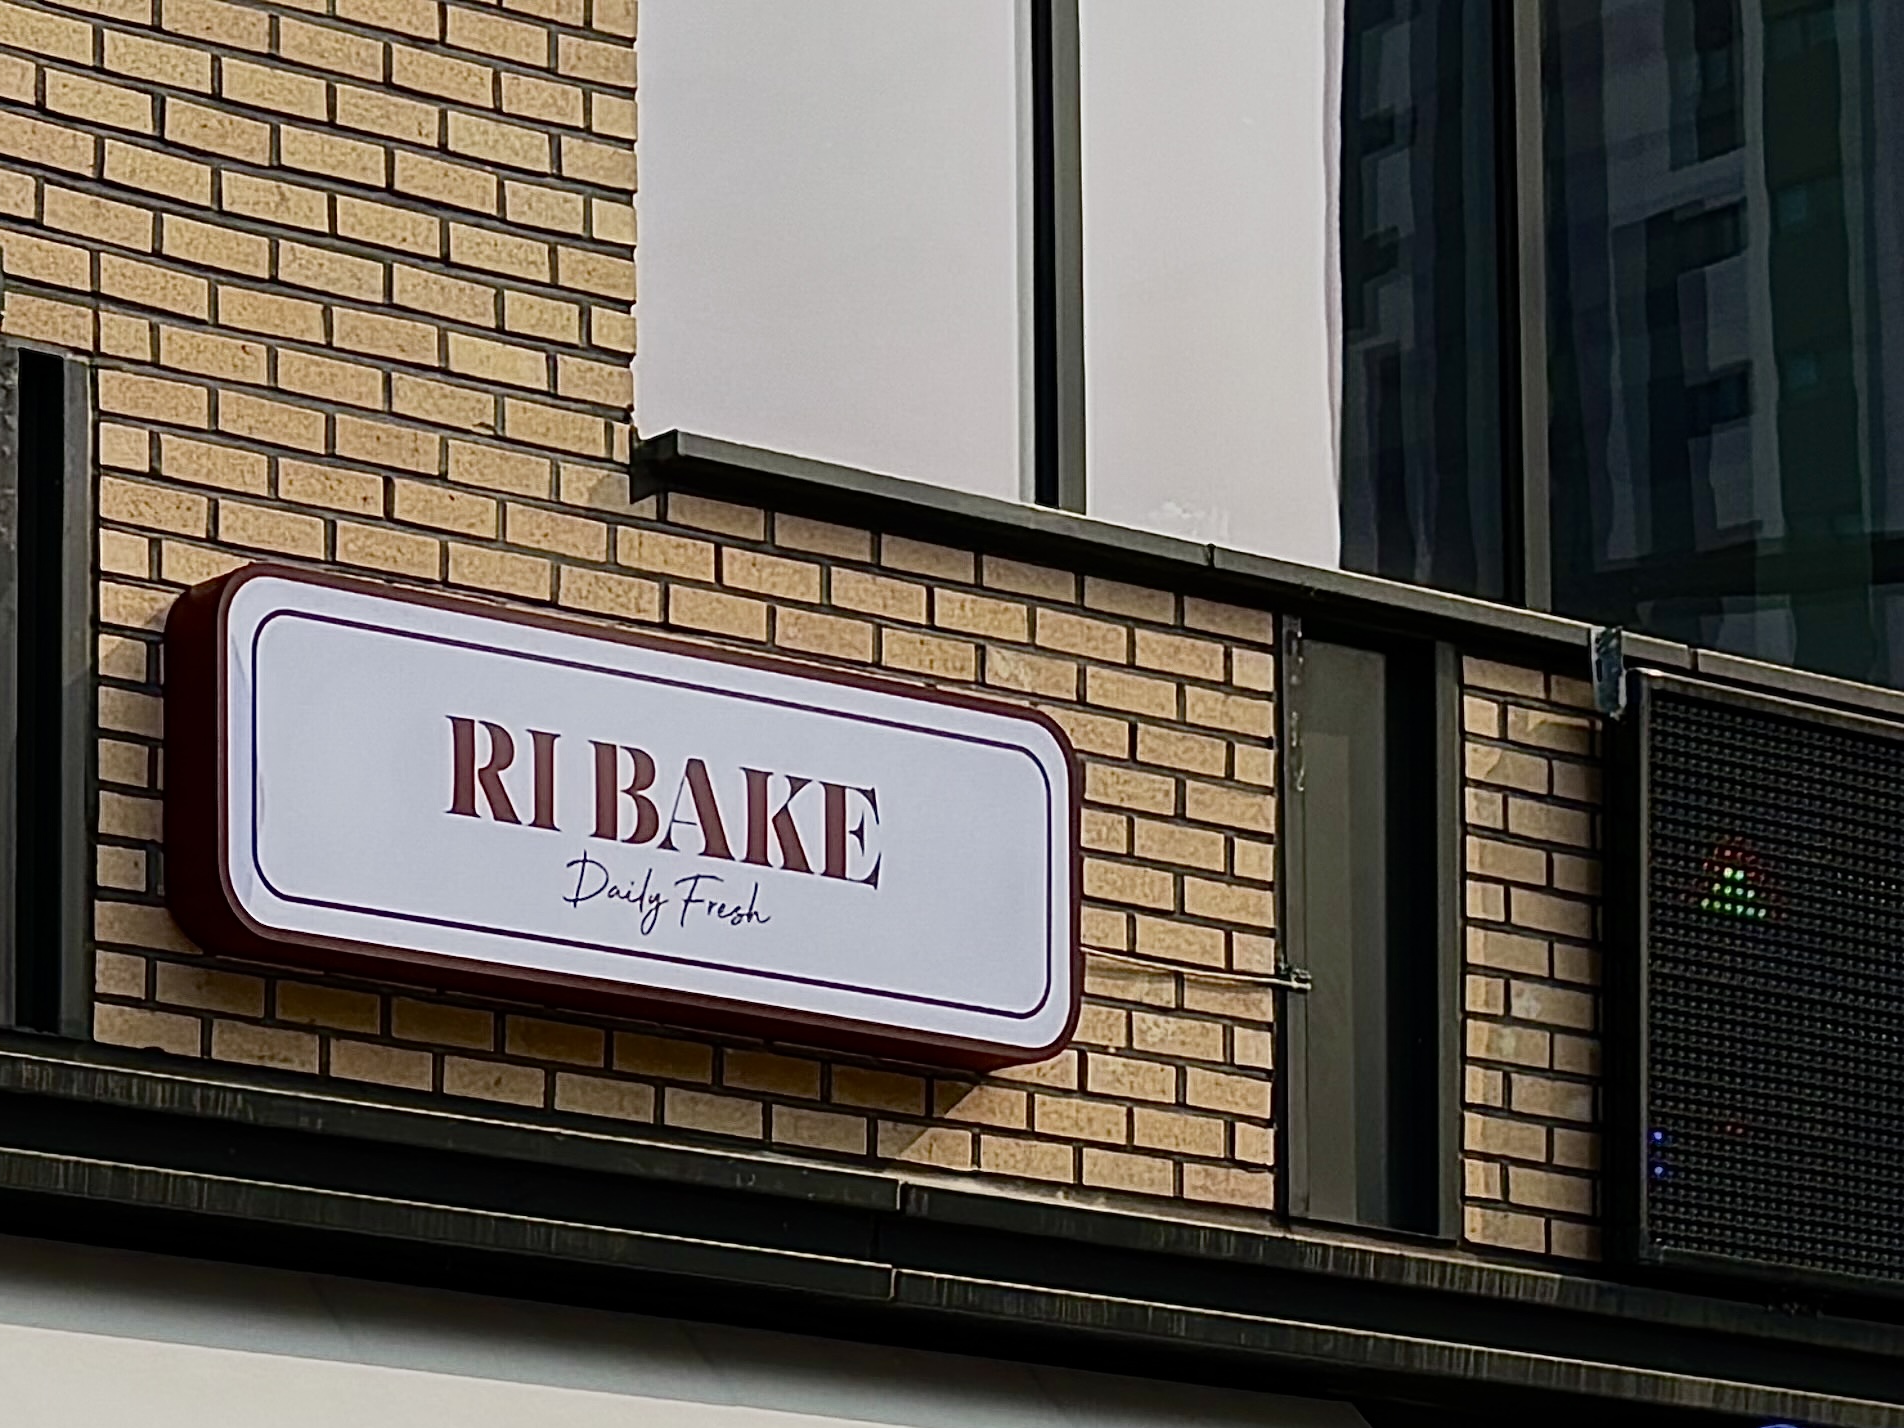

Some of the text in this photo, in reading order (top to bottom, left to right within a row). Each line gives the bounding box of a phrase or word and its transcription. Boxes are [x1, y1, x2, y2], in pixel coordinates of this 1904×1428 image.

[445, 714, 882, 890] RI BAKE
[562, 850, 771, 936] Daily Fresh
